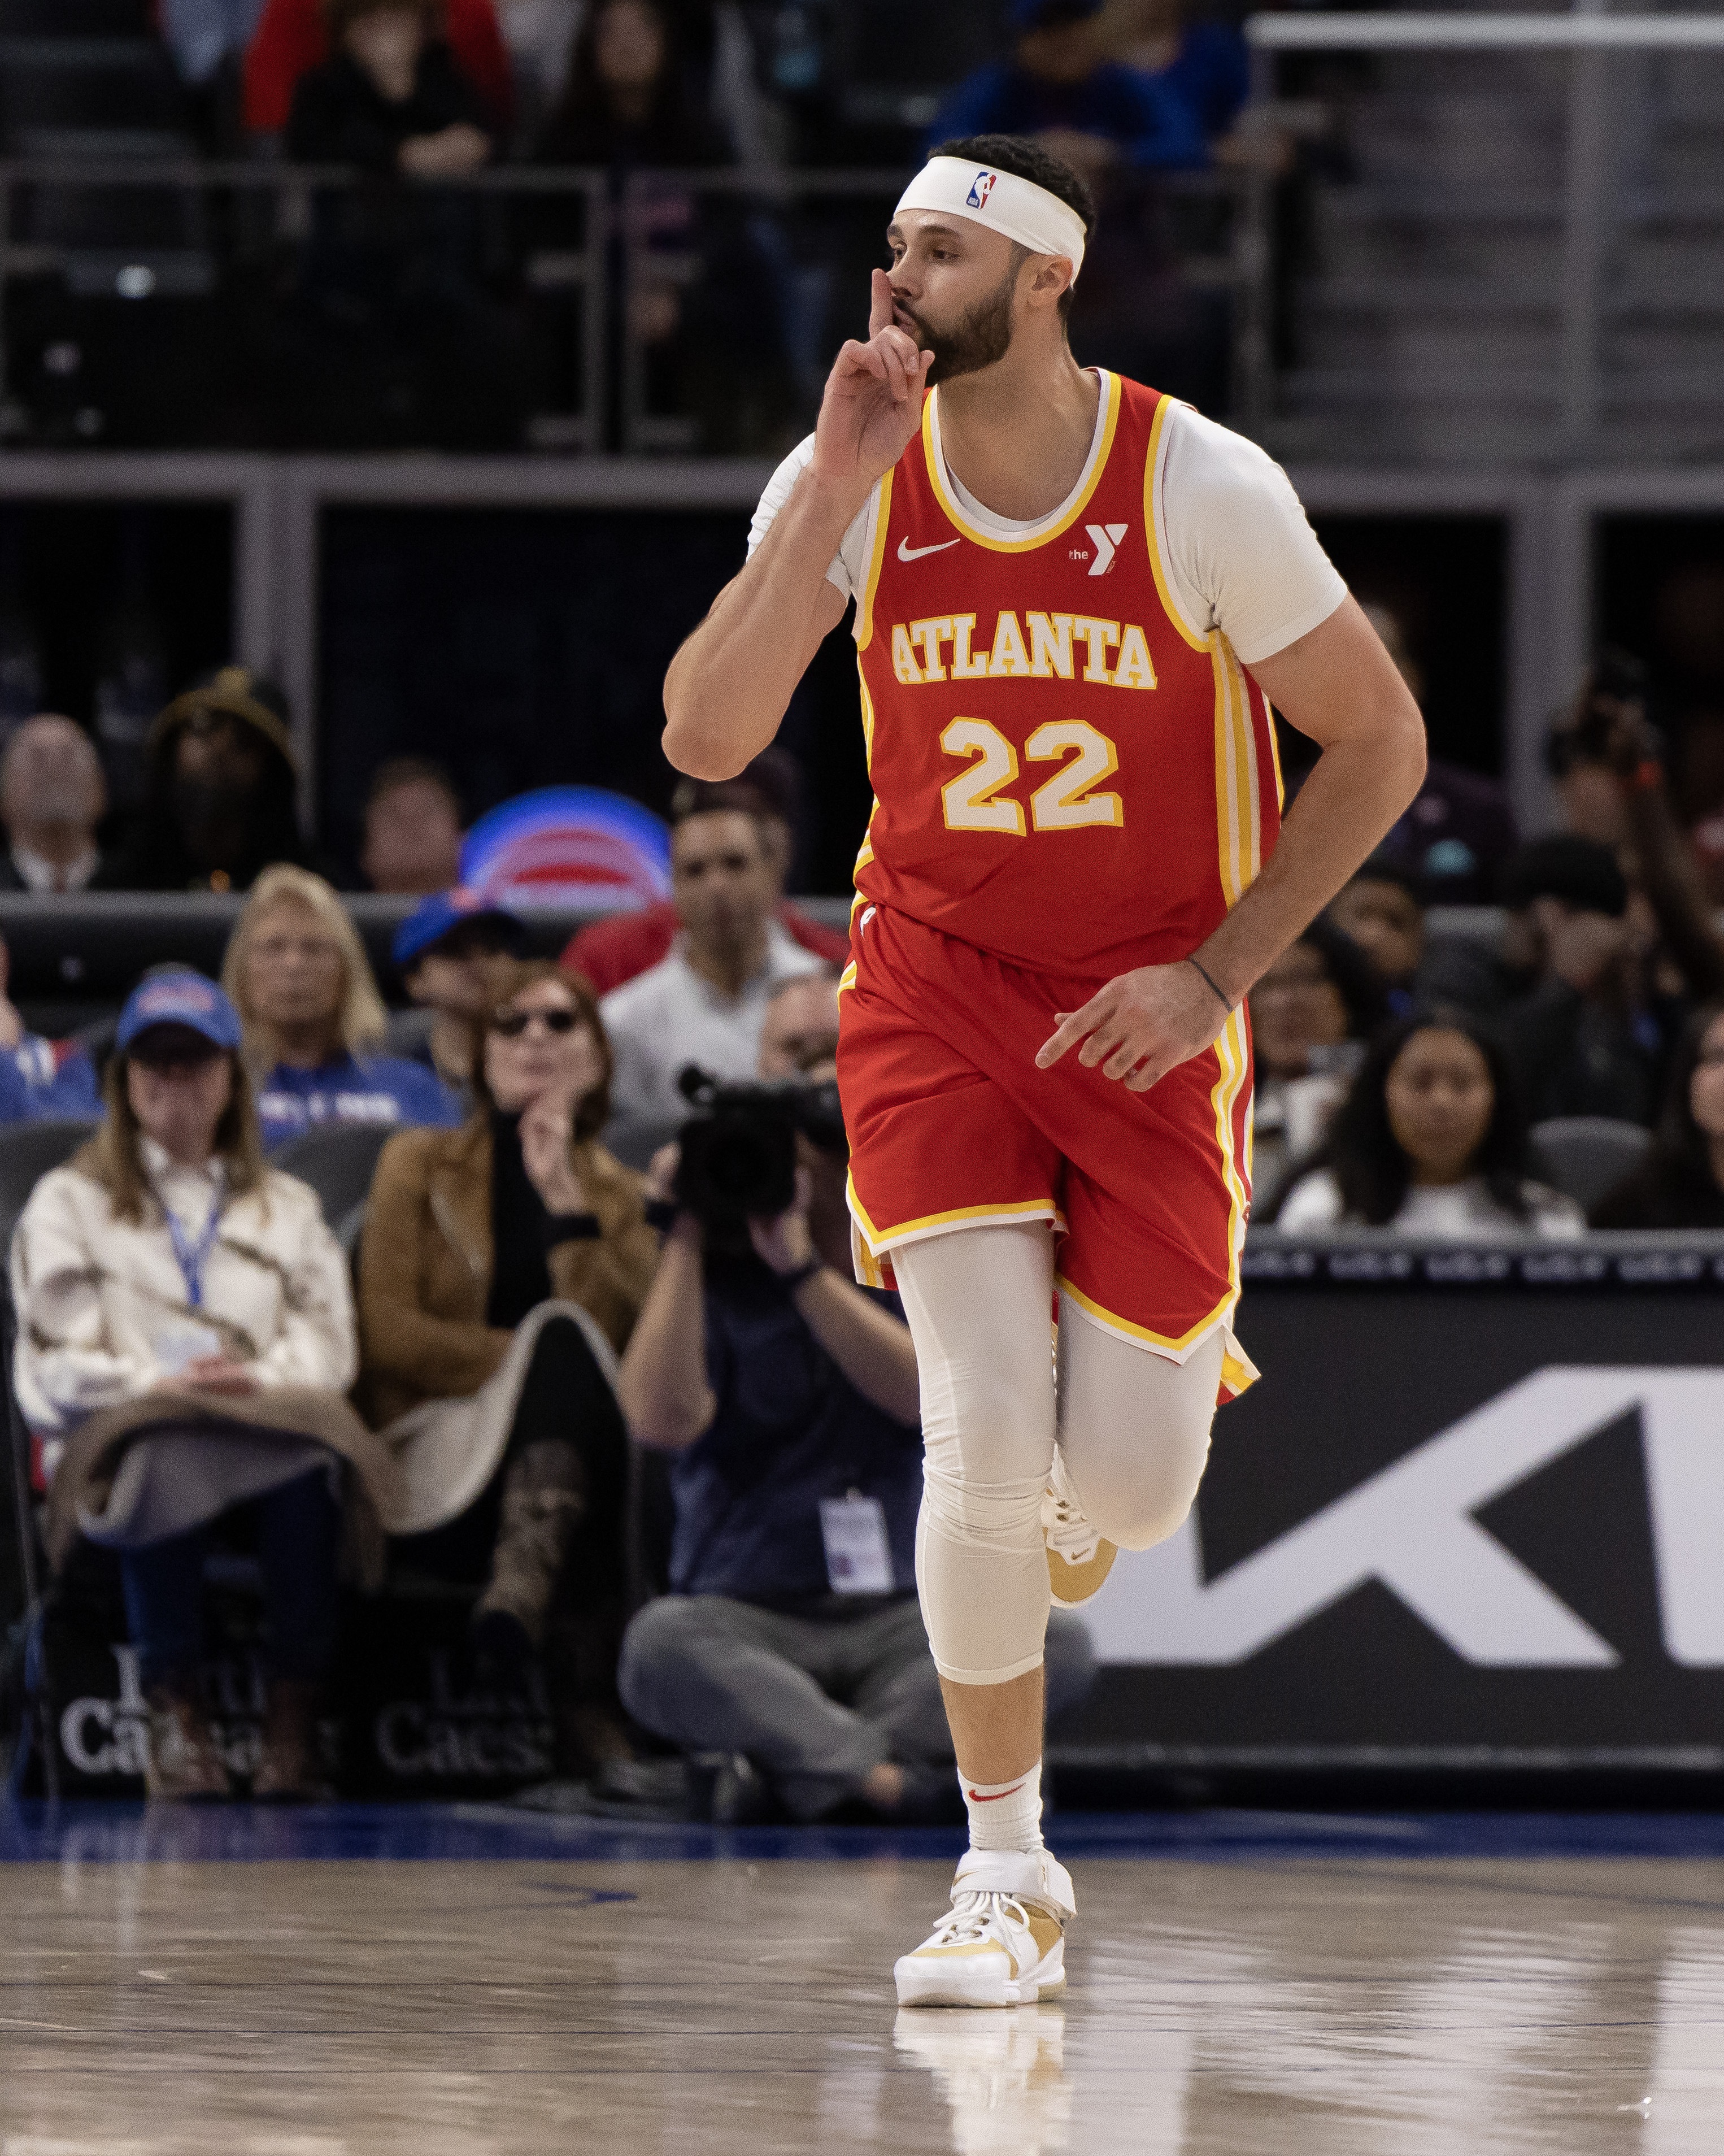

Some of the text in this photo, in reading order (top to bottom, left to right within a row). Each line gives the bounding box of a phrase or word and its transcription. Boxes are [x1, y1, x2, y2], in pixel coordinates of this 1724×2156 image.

[968, 197, 979, 206] NBA
[1069, 524, 1129, 576] the Y
[891, 610, 1158, 690] ATLANTA
[939, 716, 1124, 837] 22
